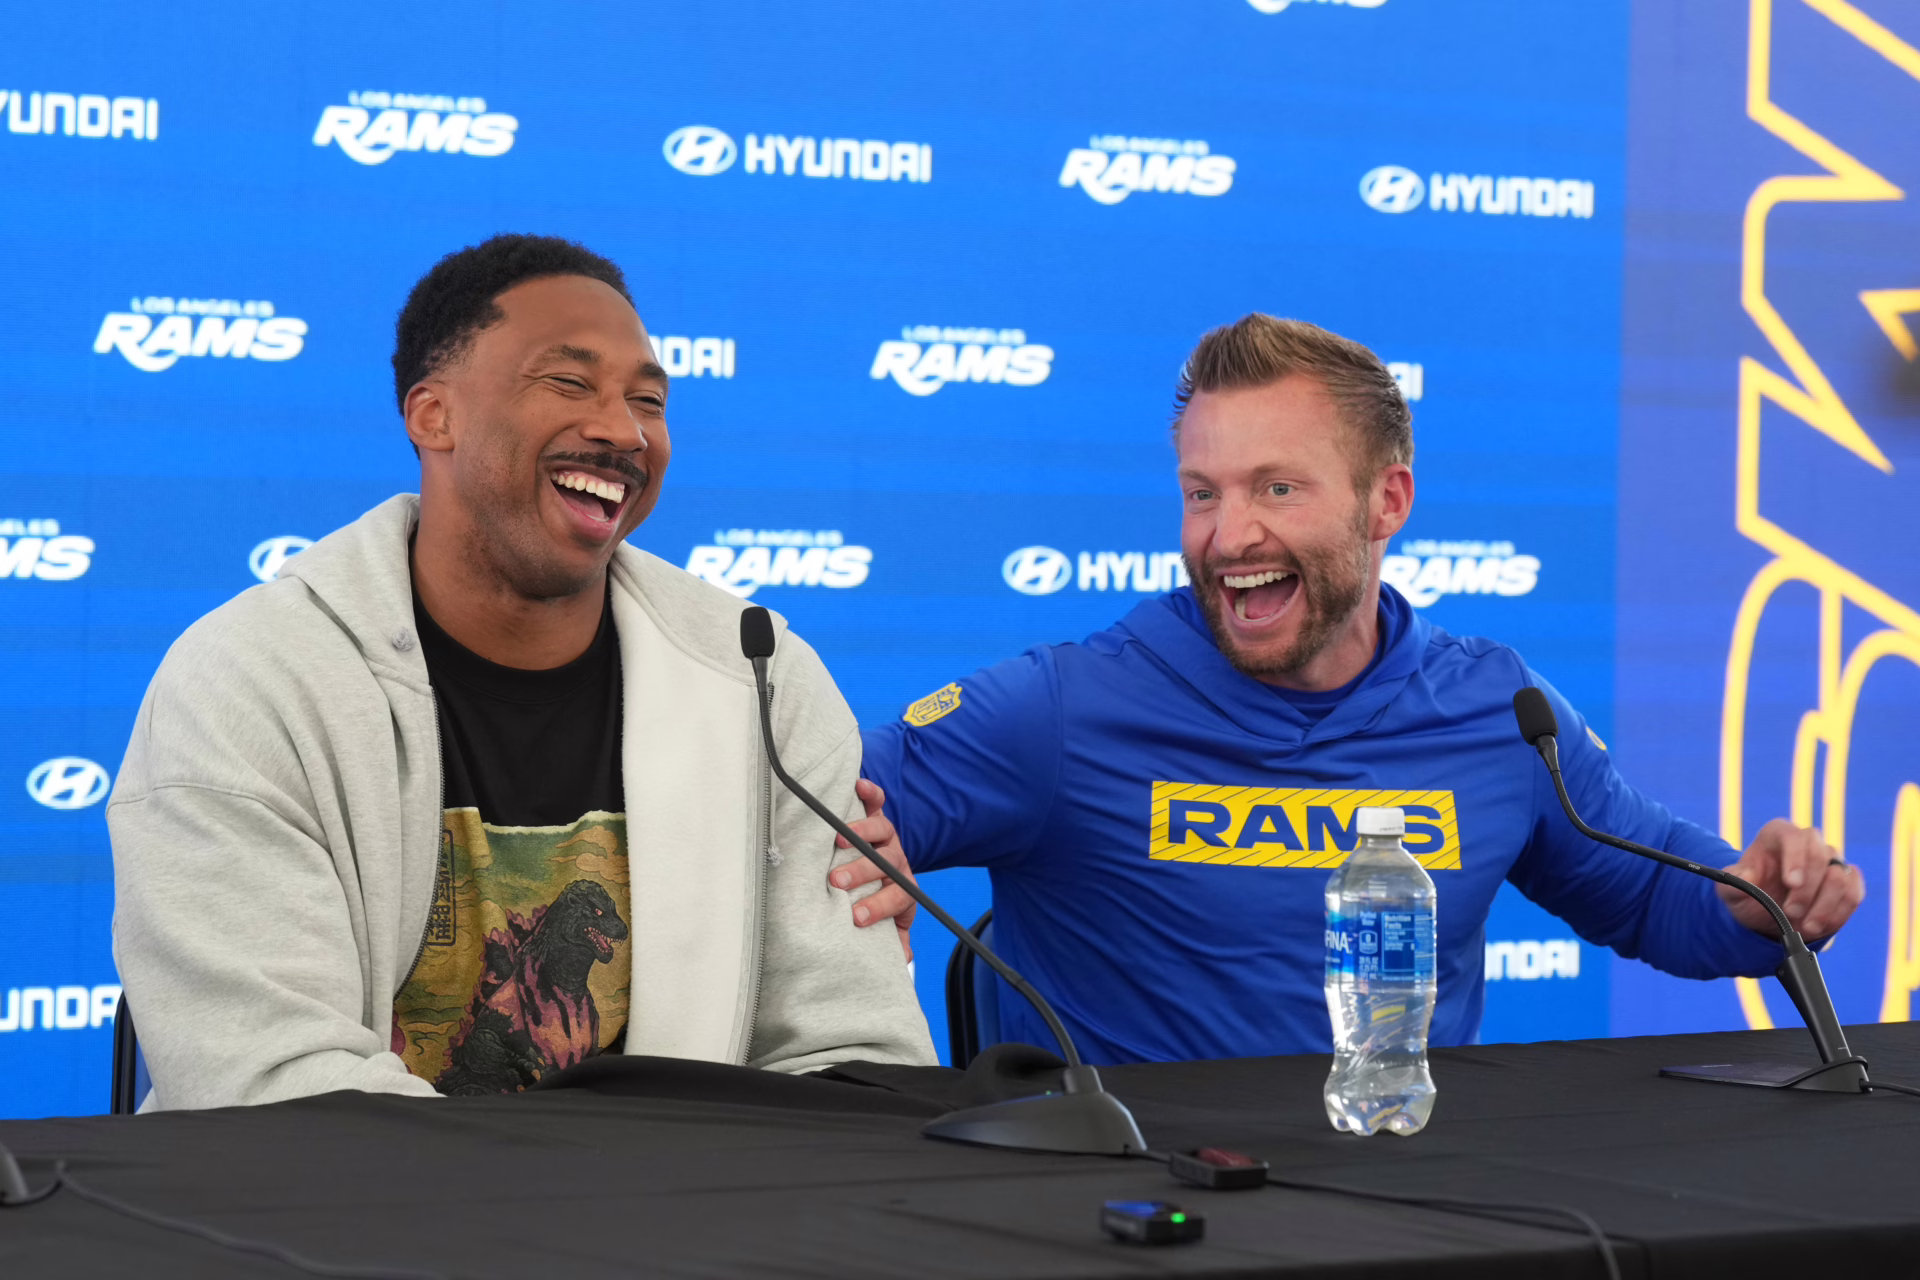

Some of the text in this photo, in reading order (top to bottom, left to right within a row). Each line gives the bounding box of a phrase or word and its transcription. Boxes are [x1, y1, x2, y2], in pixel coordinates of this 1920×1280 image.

[348, 91, 487, 113] LOS ANGELES
[313, 105, 519, 166] RAMS
[745, 134, 933, 183] HYUNDAI
[1090, 135, 1209, 155] LOS ANGELES
[1060, 148, 1237, 205] RAMS
[1429, 173, 1595, 219] HYUNDAI
[130, 296, 275, 318] LOS ANGELES
[93, 312, 309, 373] RAMS
[902, 325, 1027, 345] LOS ANGELES
[871, 340, 1055, 397] RAMS
[714, 528, 843, 547] LOS ANGELES
[1438, 540, 1515, 557] ANGELES
[686, 545, 873, 600] RAMS
[1380, 554, 1541, 608] RAMS
[1168, 799, 1446, 855] RAMS
